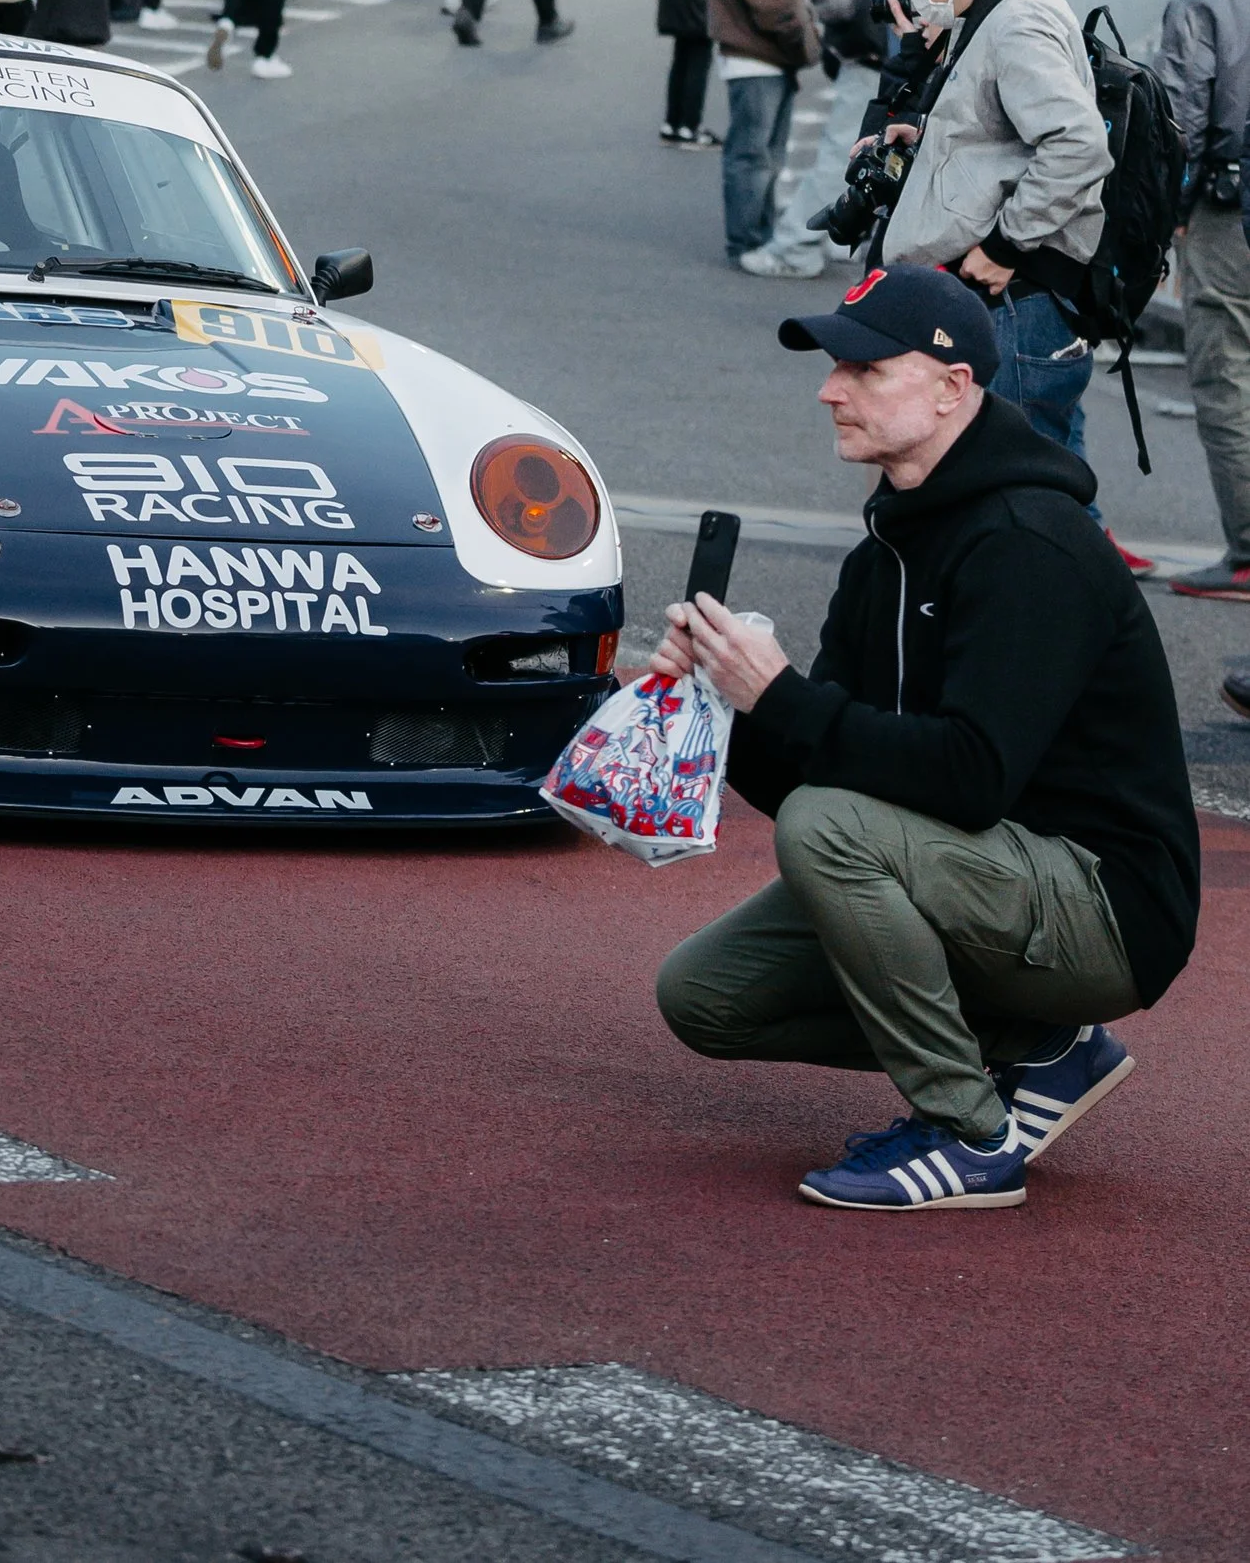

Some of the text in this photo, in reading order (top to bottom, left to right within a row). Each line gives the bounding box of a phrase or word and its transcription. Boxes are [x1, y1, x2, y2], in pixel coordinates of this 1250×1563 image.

[200, 307, 356, 362] 910
[31, 398, 304, 436] A PROJECT
[63, 452, 338, 498] 910
[80, 493, 356, 530] RACING
[105, 544, 382, 595] HANWA
[120, 588, 389, 636] HOSPITAL
[110, 785, 374, 811] ADVAN
